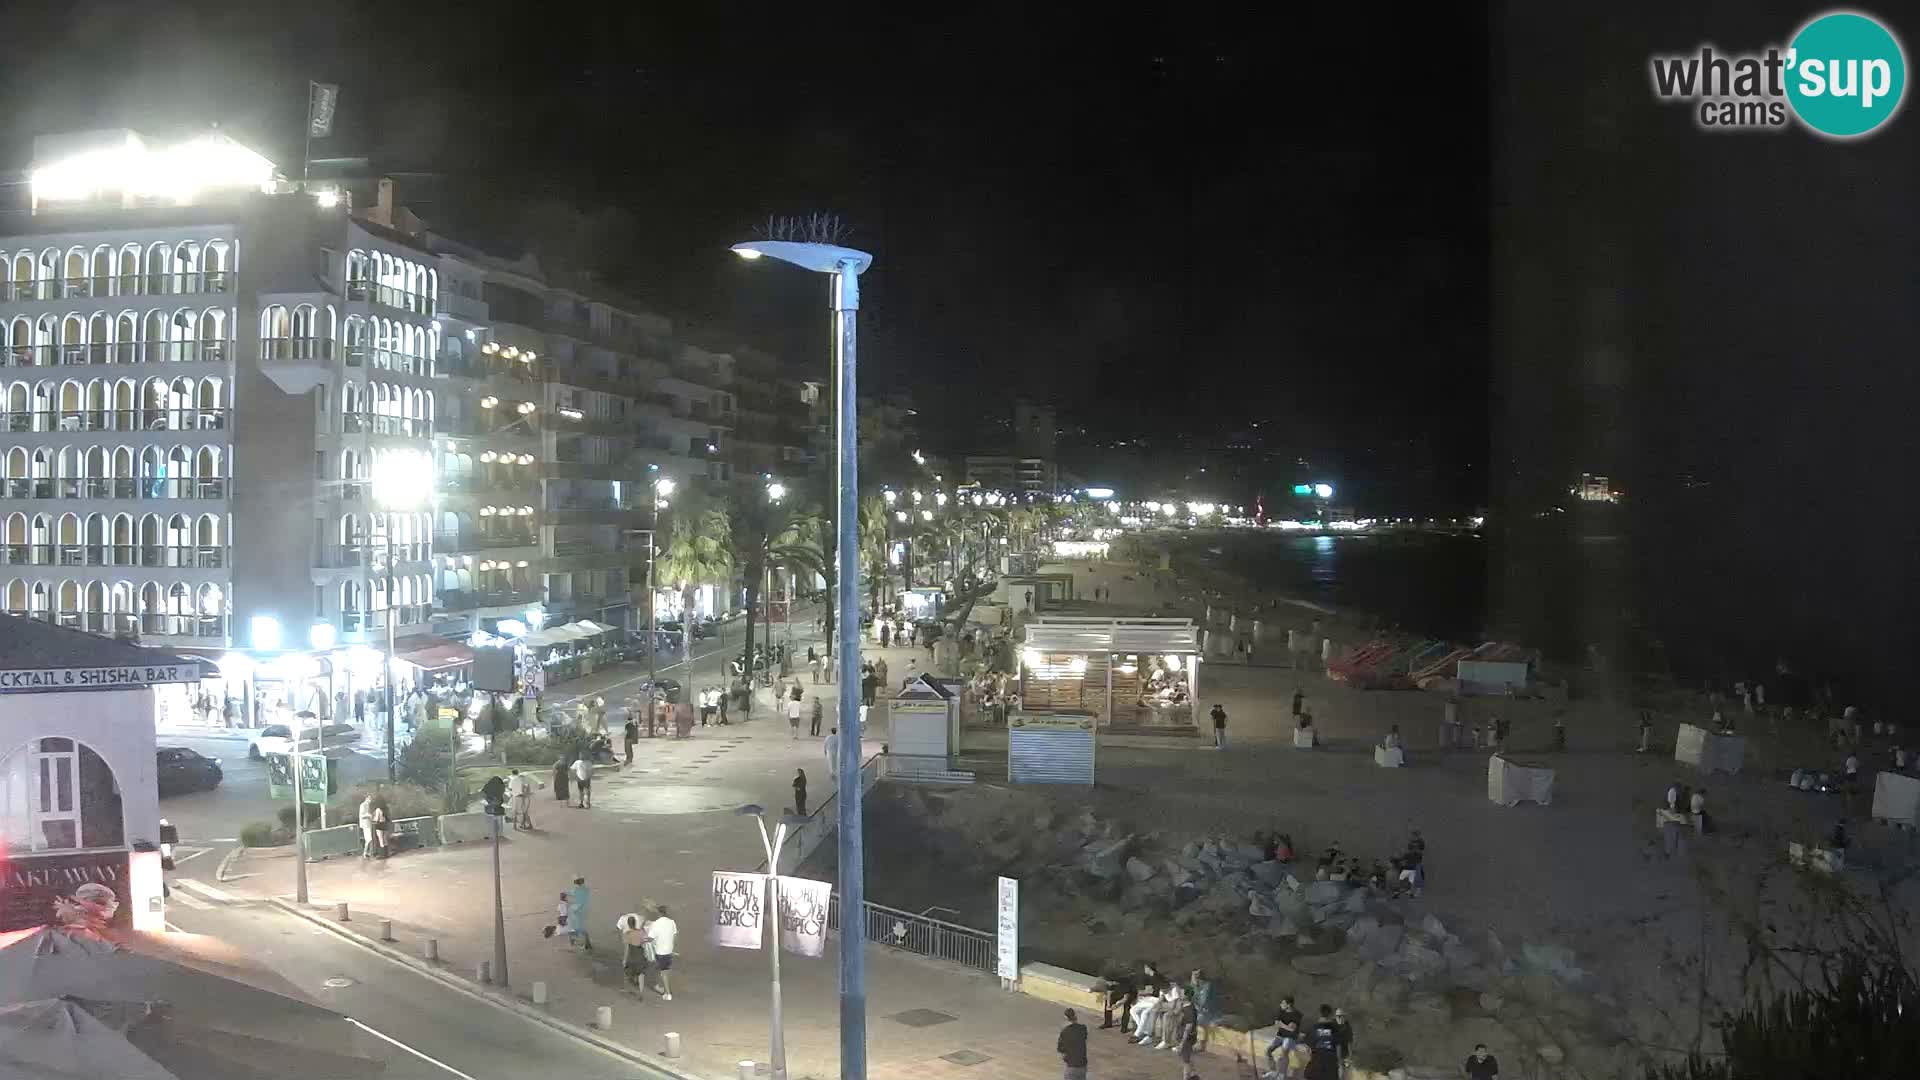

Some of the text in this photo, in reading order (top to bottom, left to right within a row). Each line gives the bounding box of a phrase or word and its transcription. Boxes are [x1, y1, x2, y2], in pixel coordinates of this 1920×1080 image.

[64, 671, 75, 684] &
[79, 669, 141, 684] SHISHA
[144, 667, 178, 682] BAR
[718, 910, 760, 928] ESPECT
